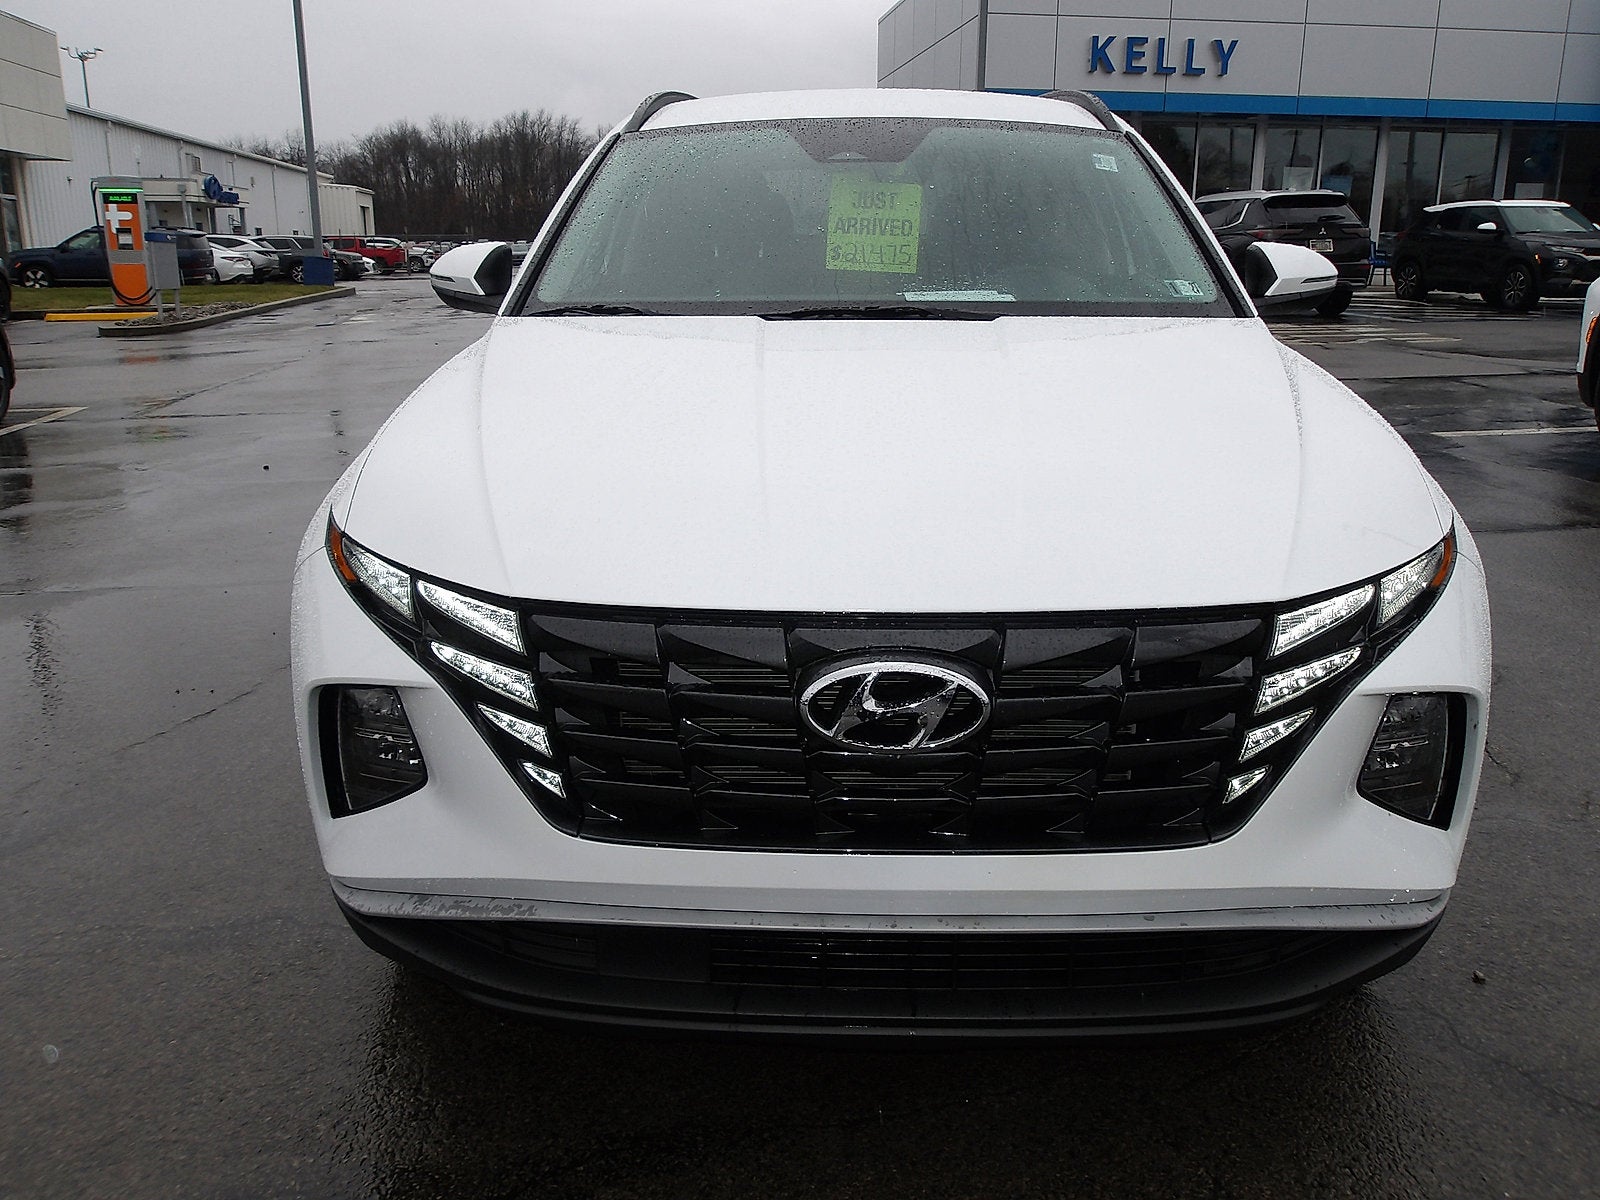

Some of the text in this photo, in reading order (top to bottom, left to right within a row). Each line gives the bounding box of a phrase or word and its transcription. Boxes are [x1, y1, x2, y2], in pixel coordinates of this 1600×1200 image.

[1088, 35, 1239, 76] KELLY
[851, 190, 898, 210] JUST
[833, 216, 913, 237] ARRIVED
